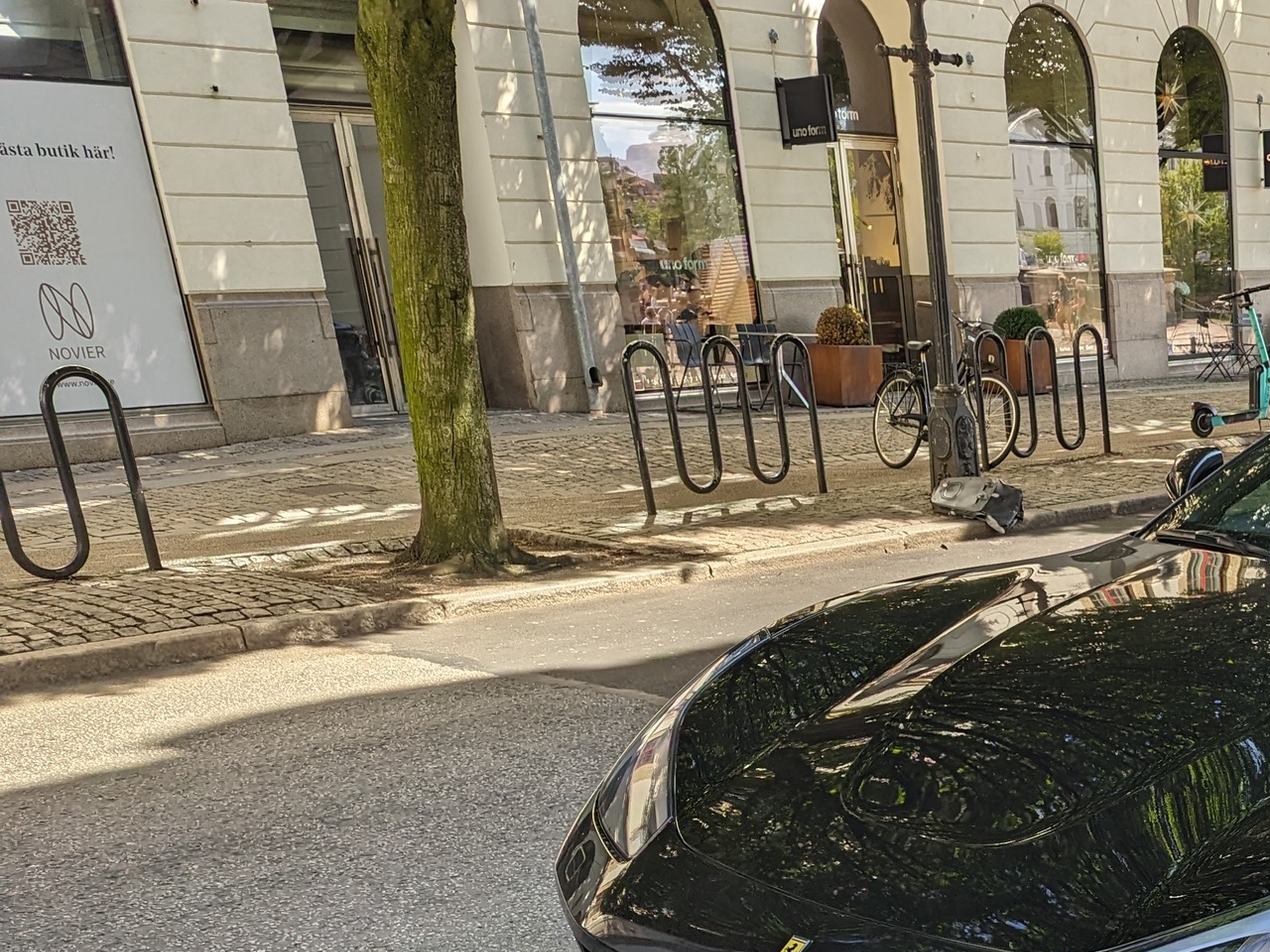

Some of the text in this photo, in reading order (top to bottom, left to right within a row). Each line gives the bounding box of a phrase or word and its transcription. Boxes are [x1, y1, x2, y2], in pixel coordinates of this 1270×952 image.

[793, 124, 826, 137] uno form
[34, 142, 80, 158] butik
[82, 144, 115, 160] här!
[683, 256, 708, 270] form
[49, 345, 106, 361] NOVIER
